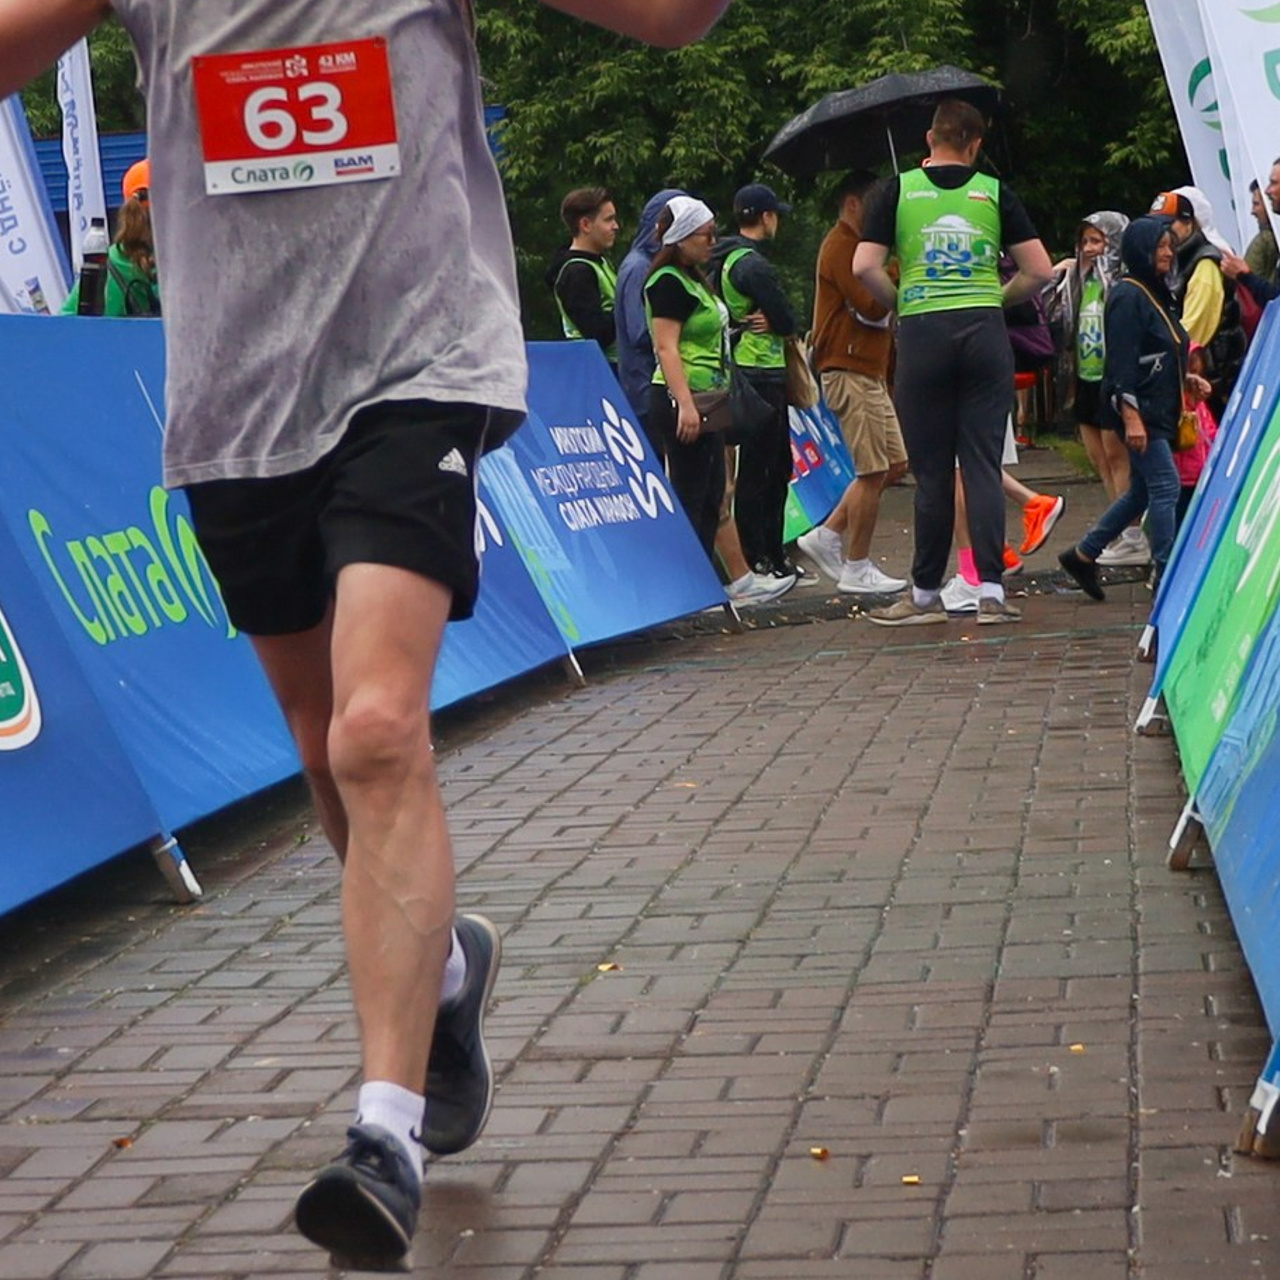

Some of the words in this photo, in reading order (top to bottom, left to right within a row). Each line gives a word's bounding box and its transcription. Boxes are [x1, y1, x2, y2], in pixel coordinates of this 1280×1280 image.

[243, 81, 349, 151] 63
[231, 166, 291, 185] Слата
[334, 155, 375, 169] БАМ
[27, 508, 188, 645] Слата
